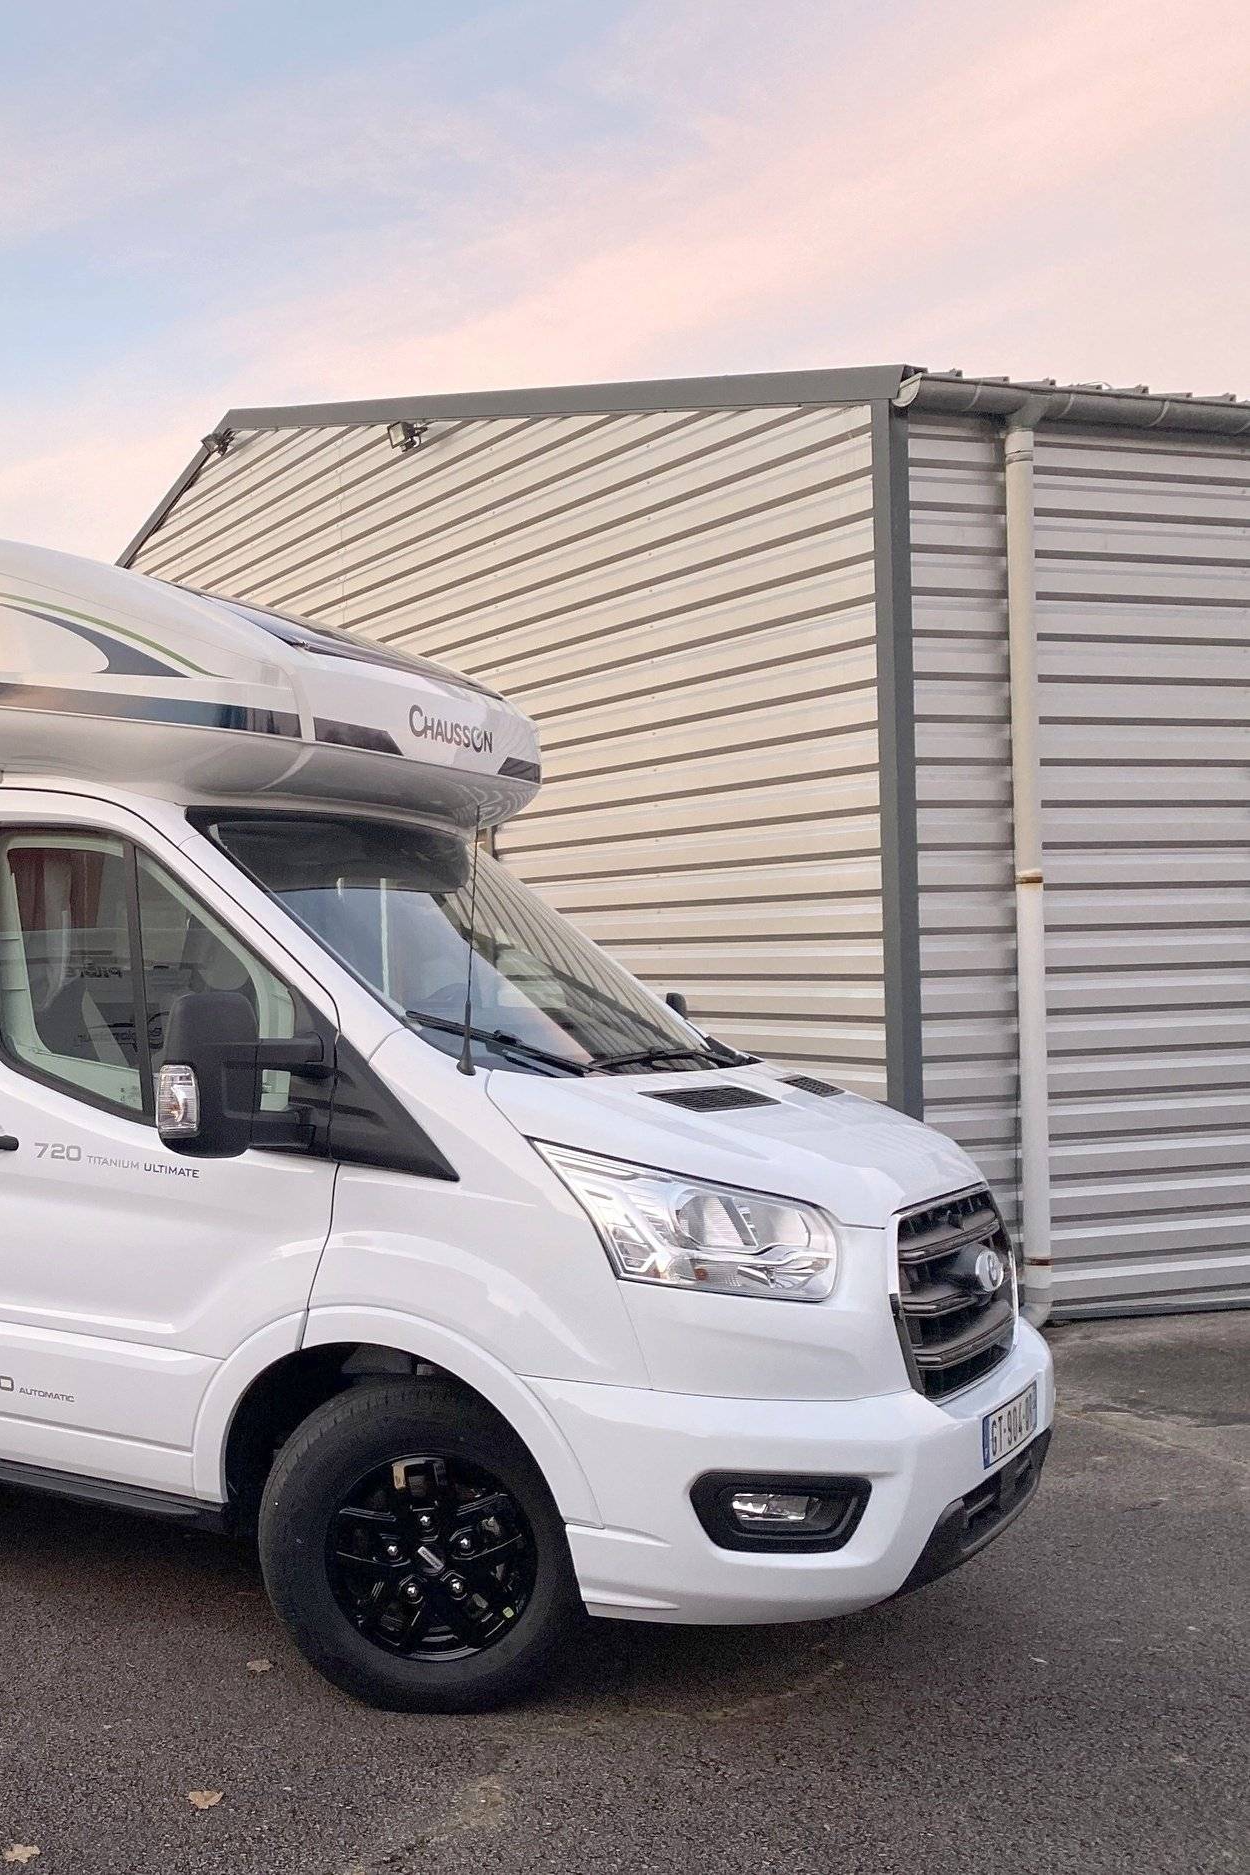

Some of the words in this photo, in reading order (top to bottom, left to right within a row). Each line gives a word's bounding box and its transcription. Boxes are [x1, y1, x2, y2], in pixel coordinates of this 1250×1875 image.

[408, 704, 493, 754] CHAUSSON
[34, 1142, 82, 1162] 720
[86, 1154, 140, 1170] TITANIUM
[143, 1162, 200, 1179] ULTIMATE
[18, 1387, 76, 1403] AUTOMATIC
